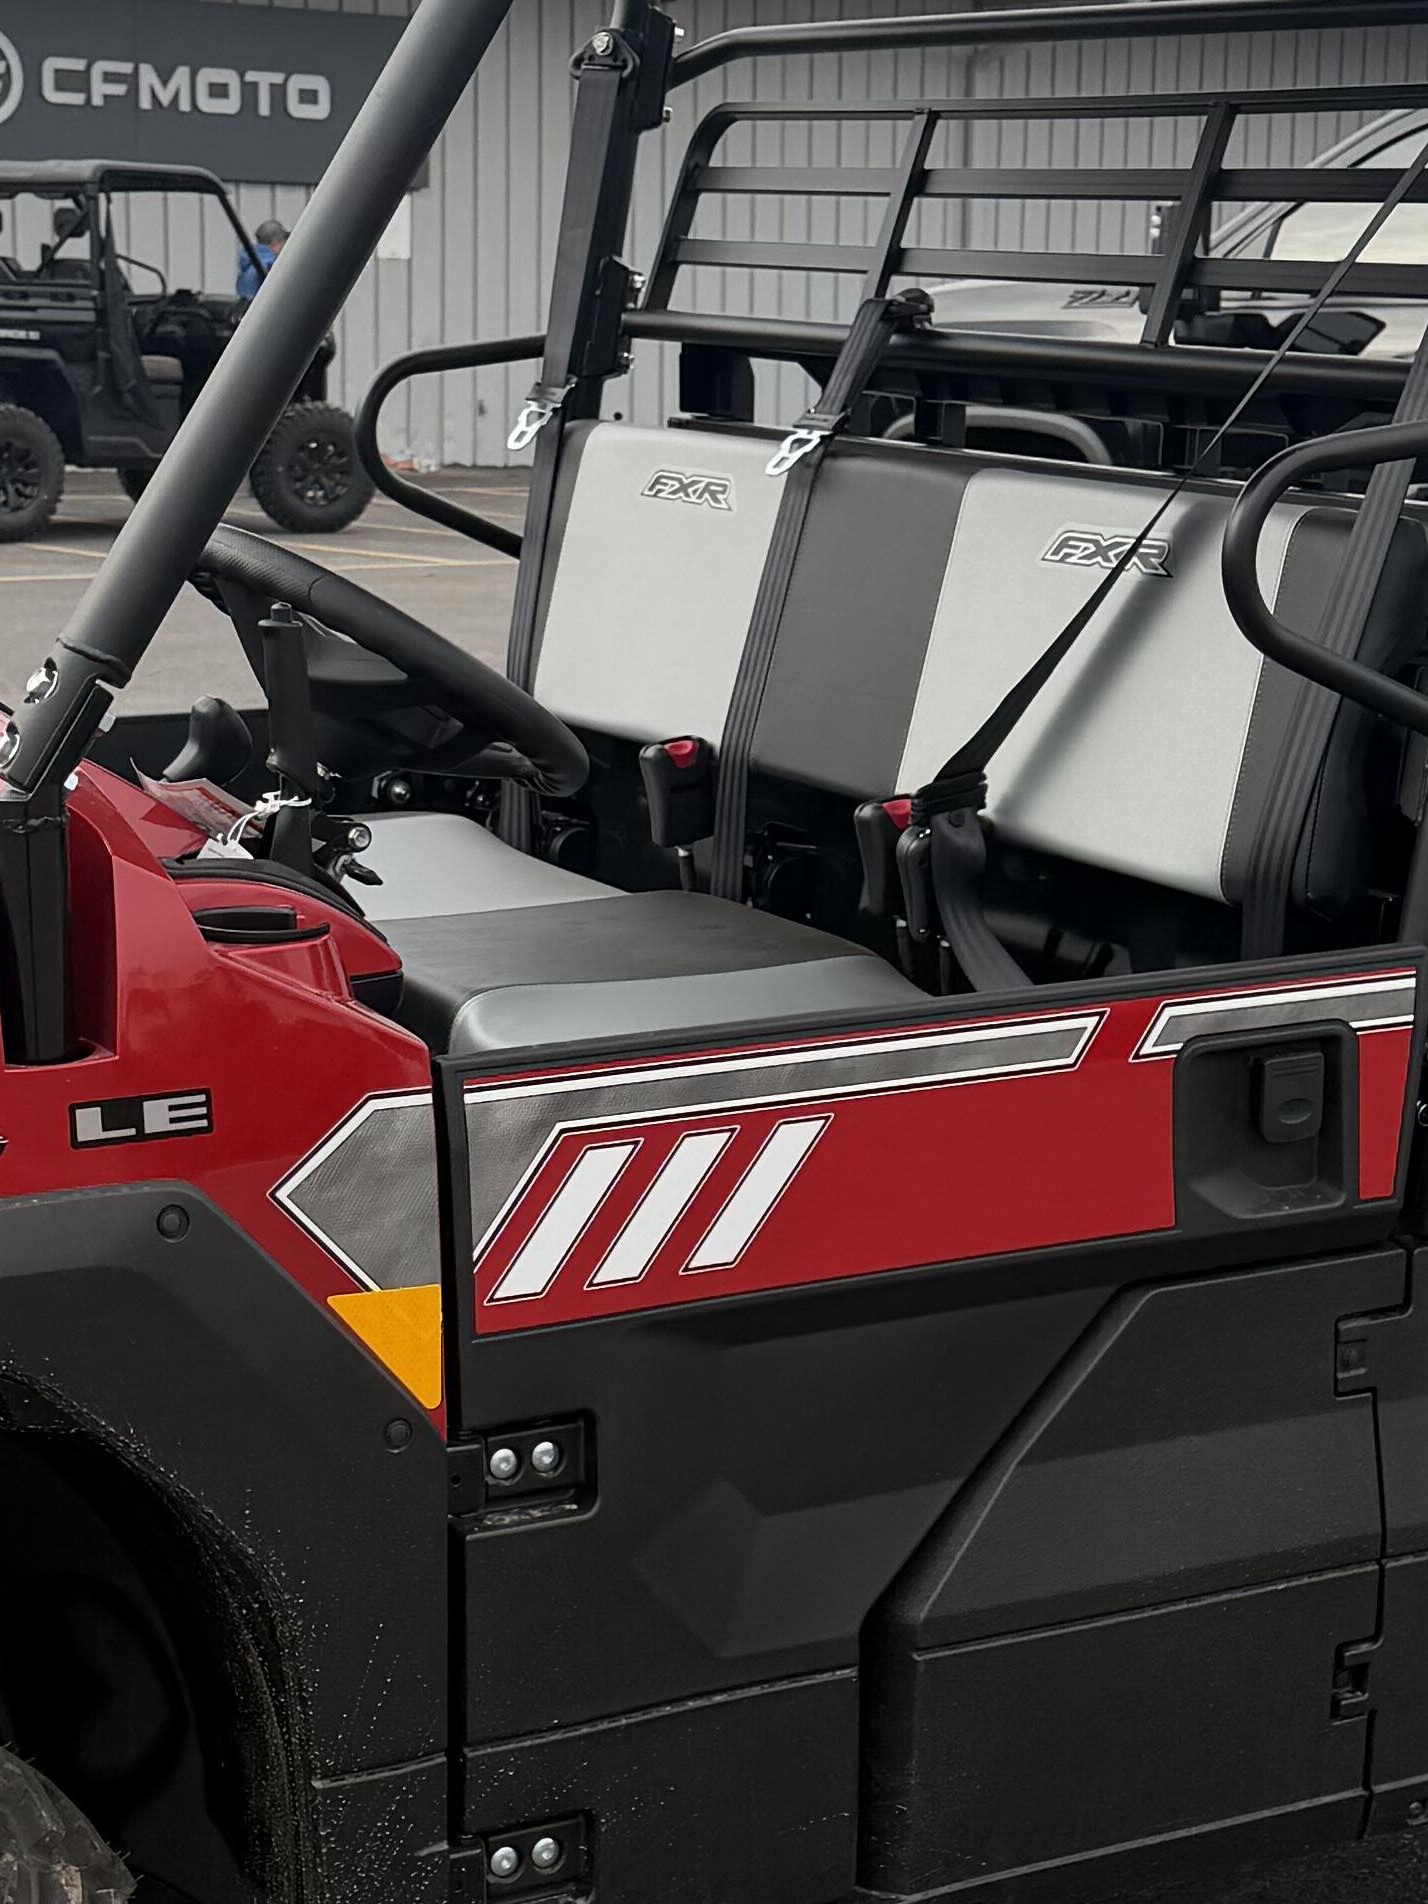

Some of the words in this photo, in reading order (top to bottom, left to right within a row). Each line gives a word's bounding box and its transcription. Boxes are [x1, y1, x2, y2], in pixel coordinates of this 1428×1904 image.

[41, 56, 332, 120] CFMOTO
[640, 469, 733, 511] FXR
[1041, 530, 1174, 578] FXR
[75, 1094, 209, 1143] LE
